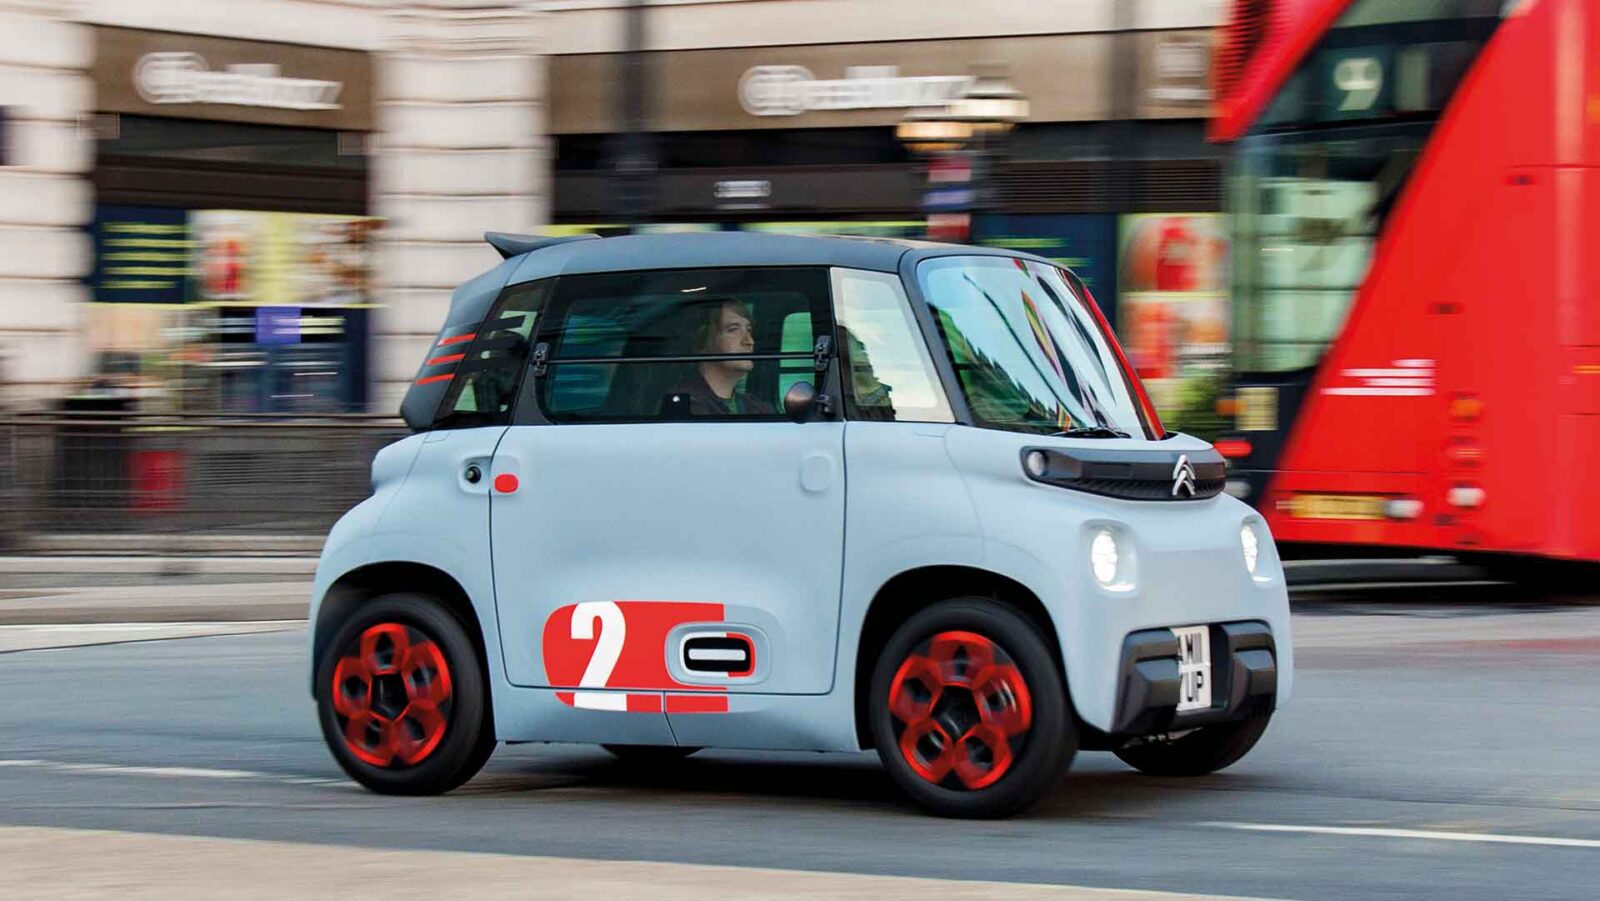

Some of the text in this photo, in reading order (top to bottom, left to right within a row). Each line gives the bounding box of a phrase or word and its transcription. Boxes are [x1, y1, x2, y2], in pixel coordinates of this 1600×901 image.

[1334, 57, 1383, 111] 9
[570, 600, 627, 711] 2
[1179, 670, 1204, 702] UP
